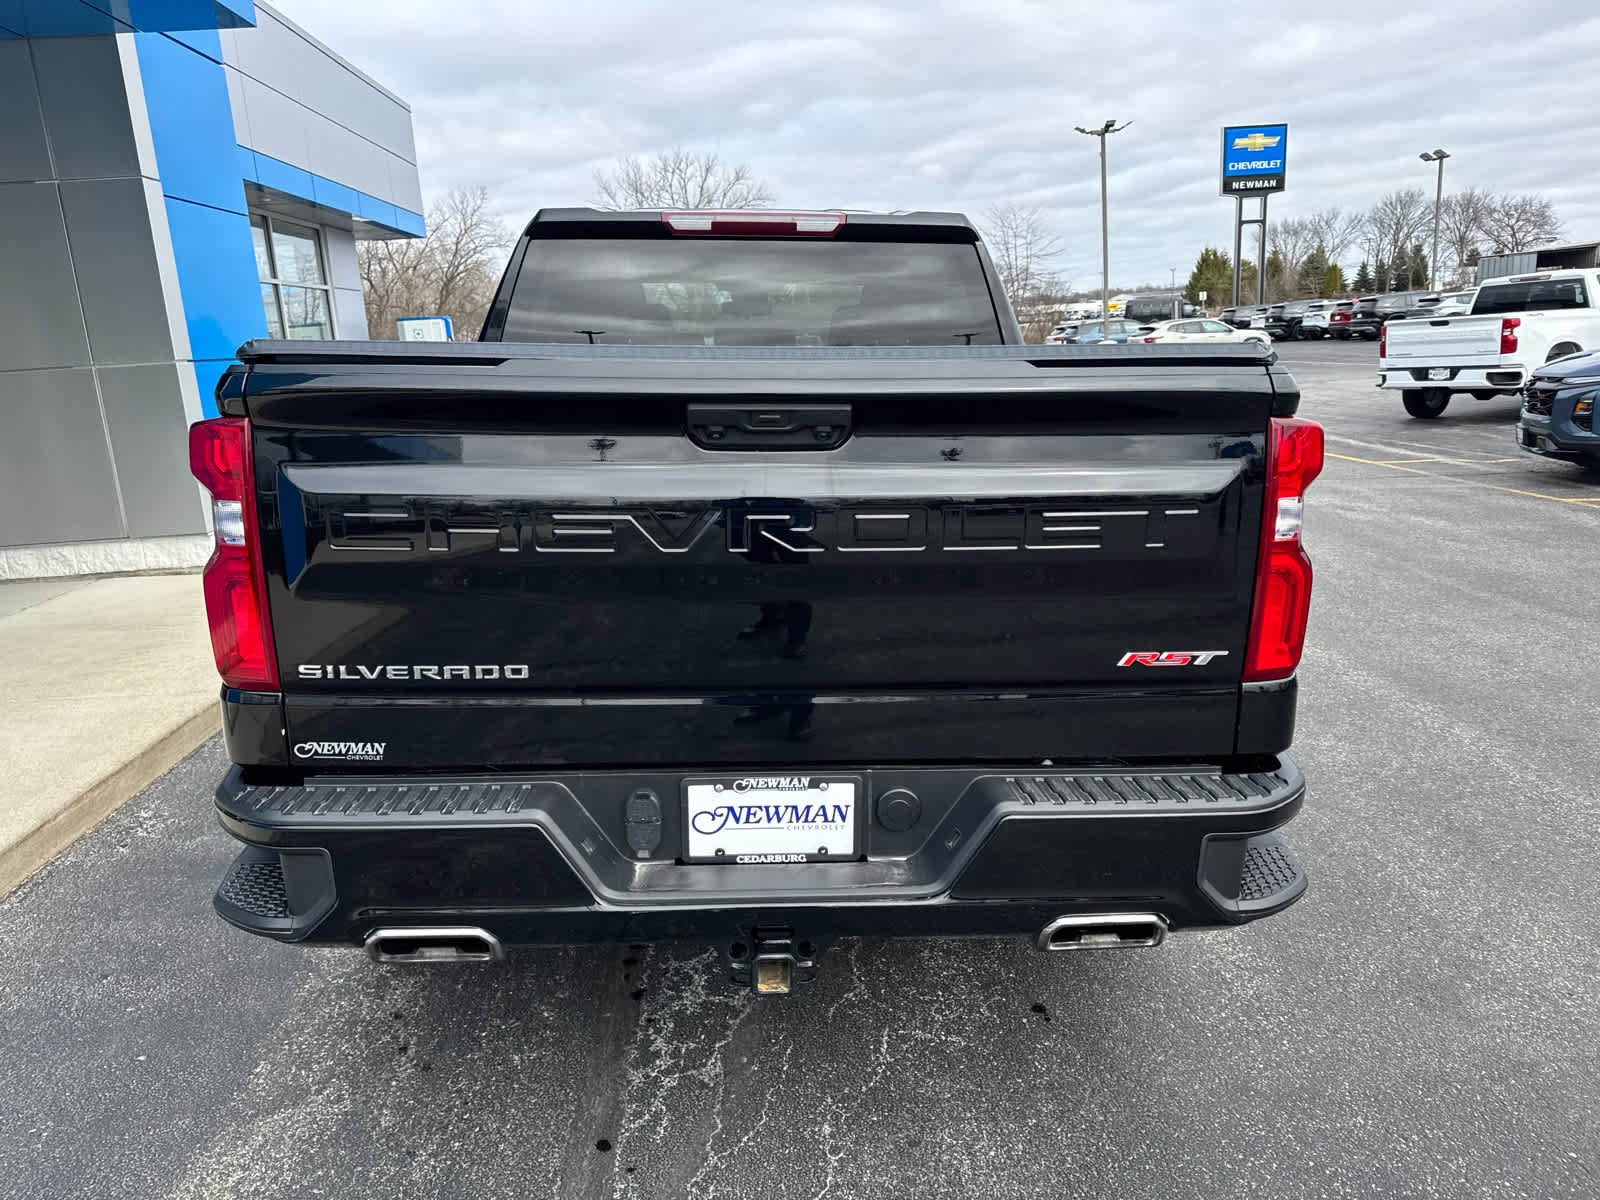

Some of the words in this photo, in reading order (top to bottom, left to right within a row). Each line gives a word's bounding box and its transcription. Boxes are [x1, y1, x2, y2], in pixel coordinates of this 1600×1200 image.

[1228, 159, 1281, 171] CHEVROLET
[1232, 179, 1277, 190] NEWMAN
[326, 504, 1200, 554] CHEVROLET
[1116, 650, 1230, 667] RST
[297, 664, 530, 681] SILVERADO
[293, 742, 387, 758] NEWMAN
[733, 777, 811, 794] NEWMAN
[691, 804, 852, 836] NEWMAN
[786, 824, 848, 832] CHEVROLET
[736, 854, 807, 864] CEDARBURG
